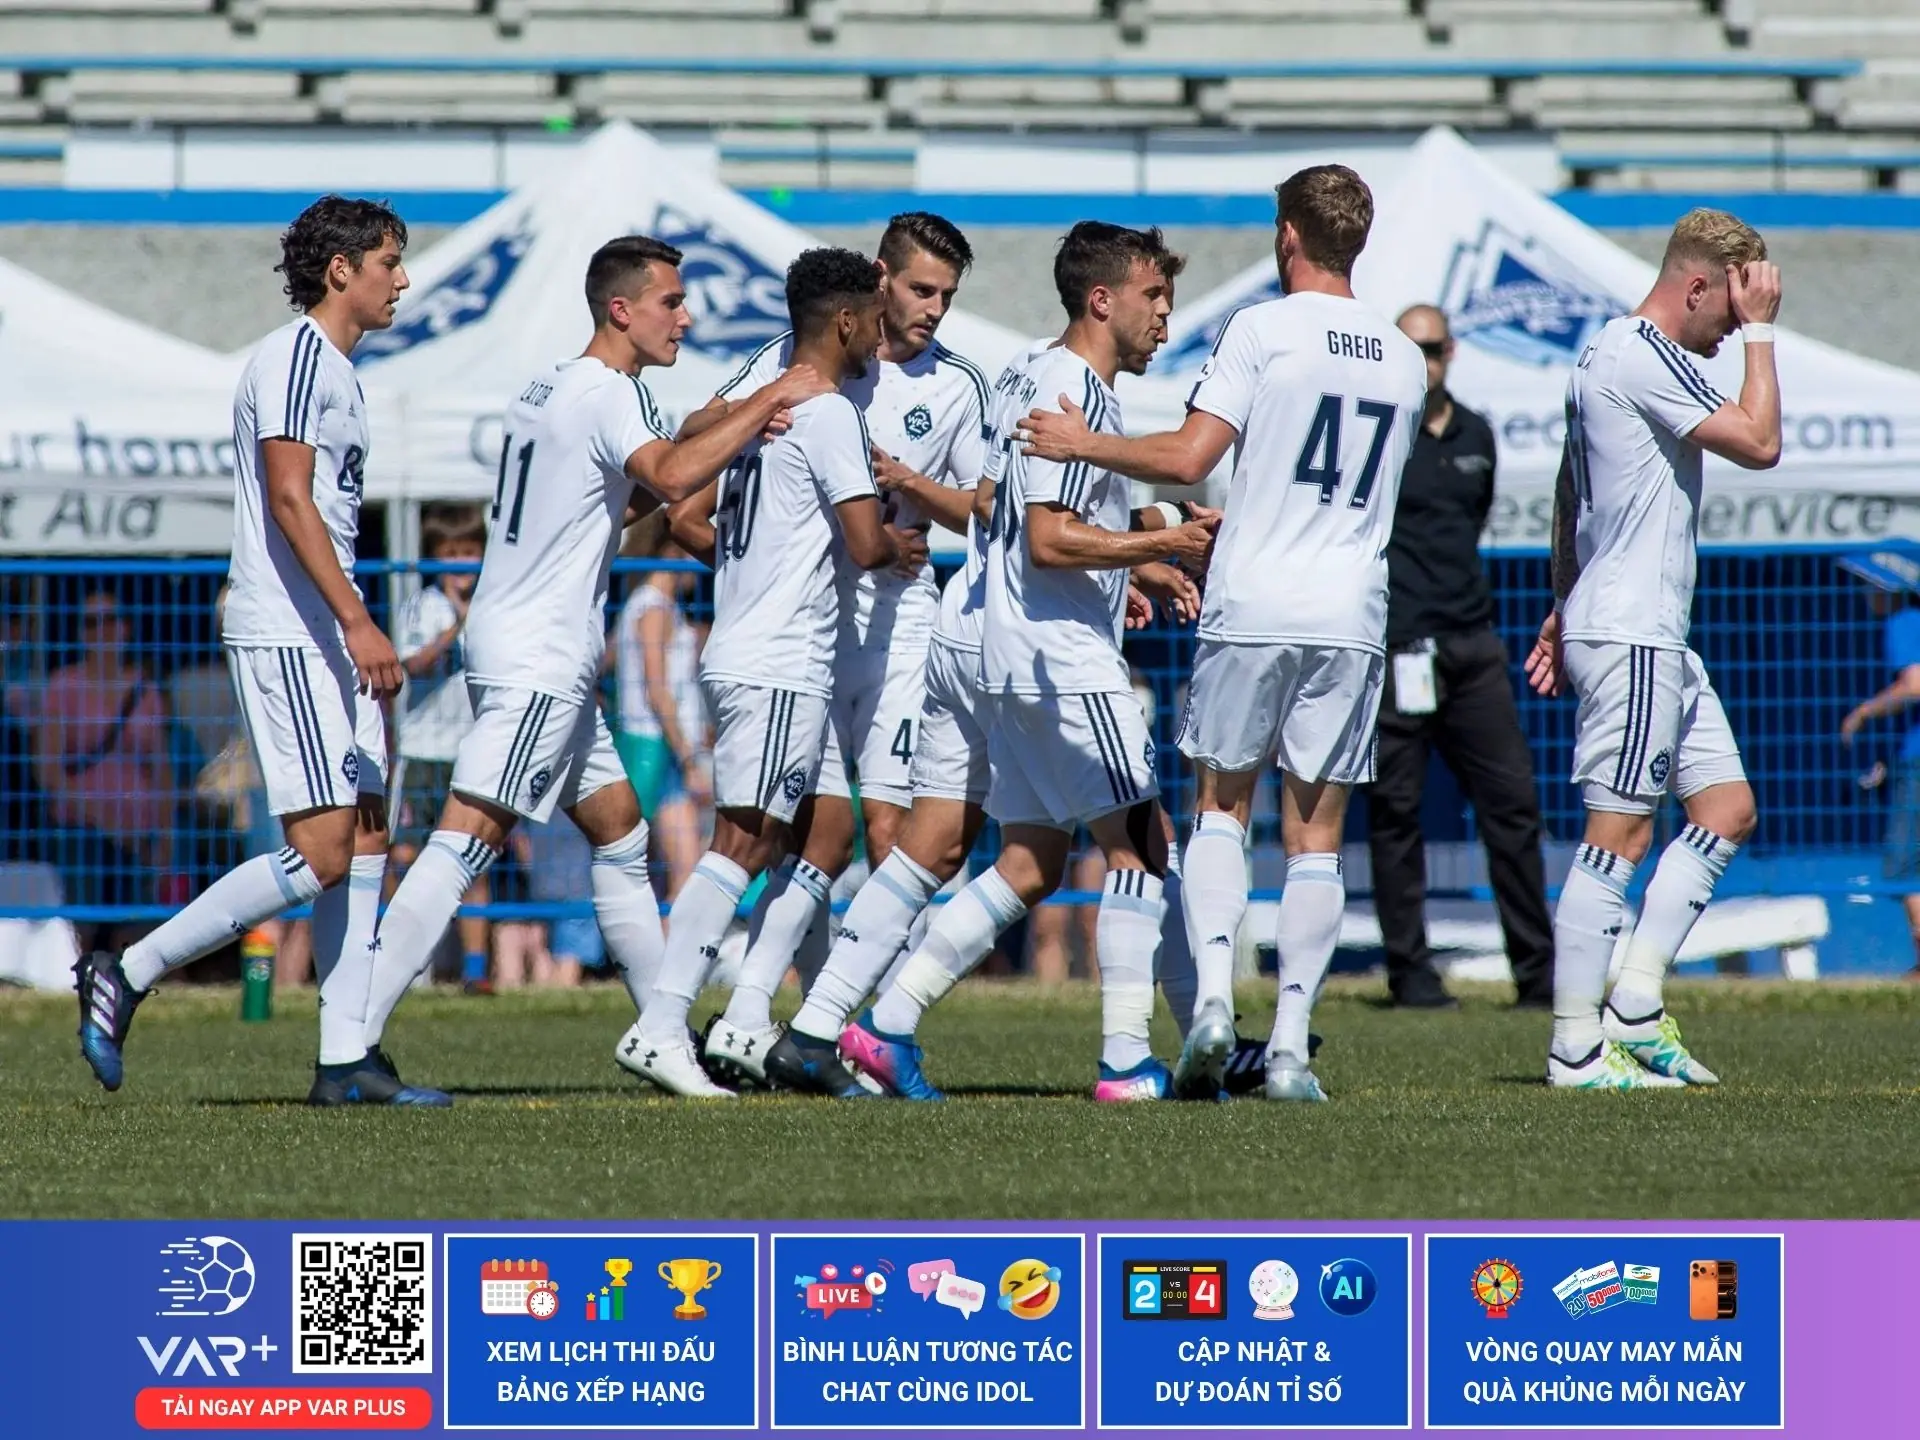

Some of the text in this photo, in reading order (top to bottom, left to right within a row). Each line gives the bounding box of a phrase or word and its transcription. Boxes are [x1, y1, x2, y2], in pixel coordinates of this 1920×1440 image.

[1326, 329, 1384, 363] GREIG
[1292, 391, 1400, 512] 47
[1699, 492, 1897, 538] ervice
[890, 718, 913, 766] 4
